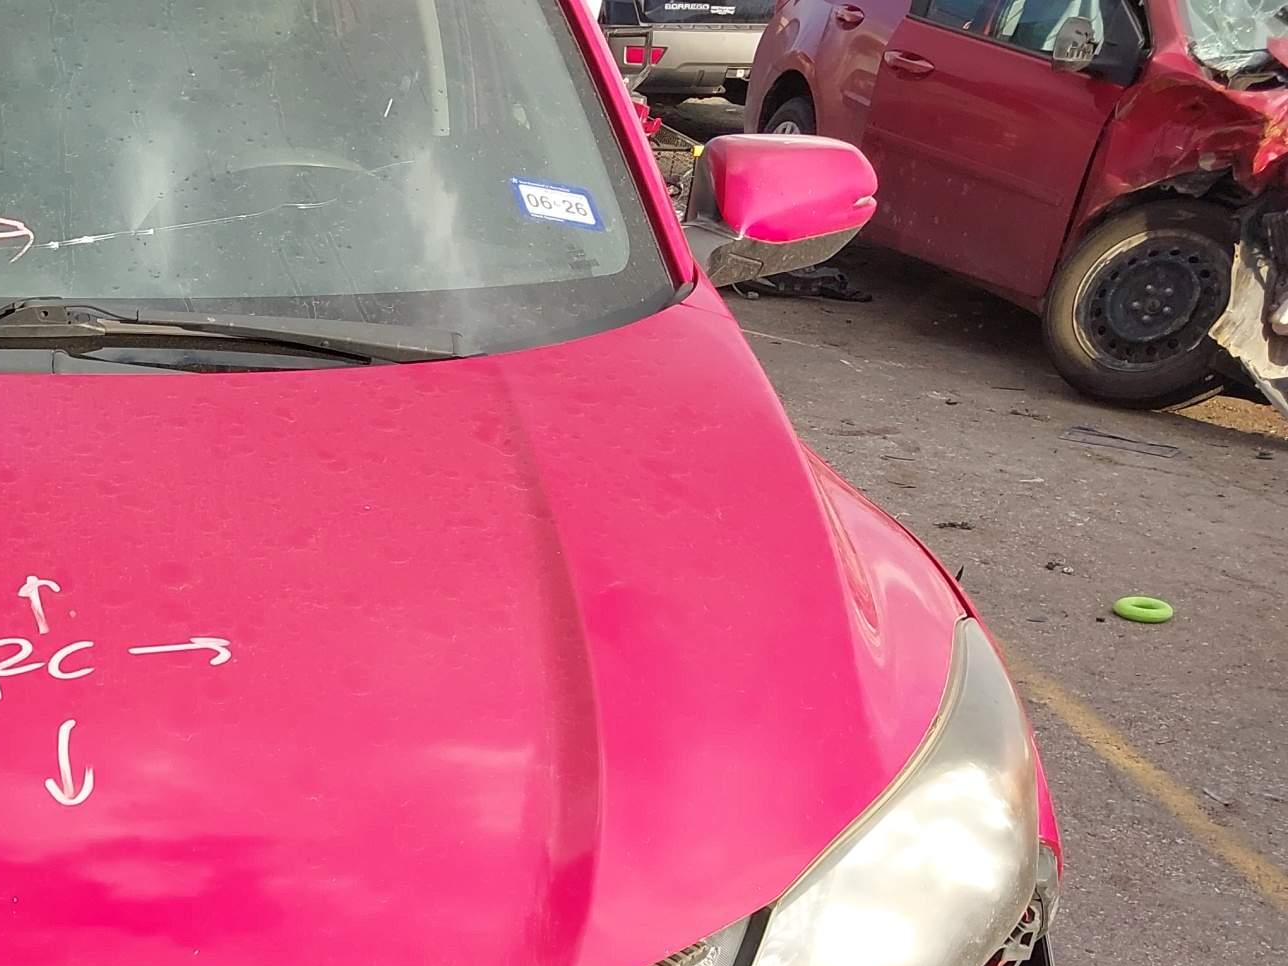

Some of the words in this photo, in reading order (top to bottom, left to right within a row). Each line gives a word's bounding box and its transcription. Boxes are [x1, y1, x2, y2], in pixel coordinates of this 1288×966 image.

[664, 3, 710, 11] BORREGO
[526, 193, 553, 210] 06
[562, 200, 588, 217] 26
